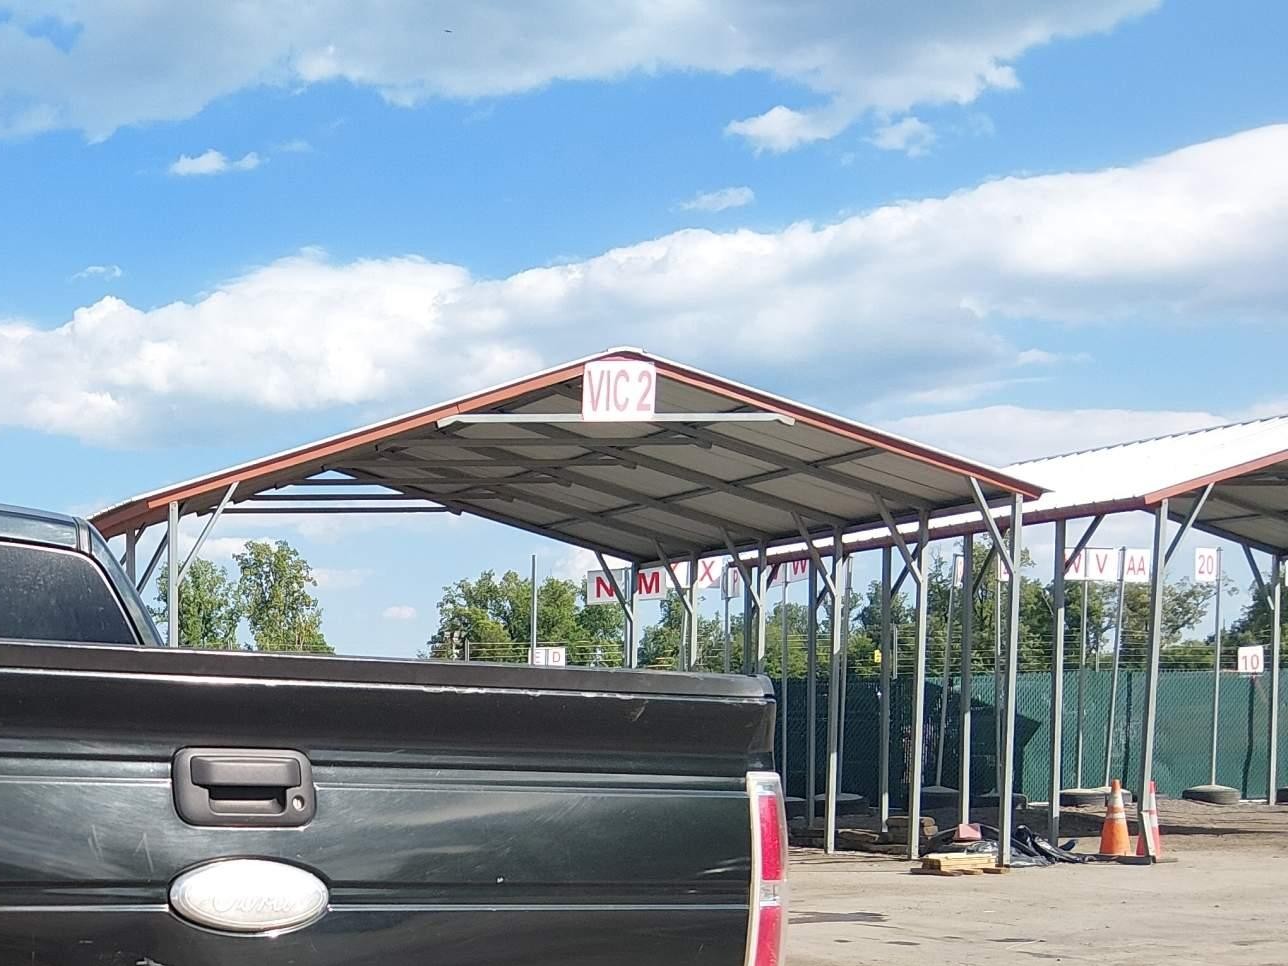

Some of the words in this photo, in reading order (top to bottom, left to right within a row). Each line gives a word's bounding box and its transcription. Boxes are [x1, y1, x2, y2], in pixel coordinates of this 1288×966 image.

[587, 369, 630, 412] VIC
[636, 370, 652, 411] 2
[699, 560, 715, 582] X
[1095, 554, 1108, 574] V
[1127, 555, 1145, 575] AA
[1198, 554, 1214, 575] 20
[596, 576, 616, 598] N
[638, 571, 660, 595] M
[552, 651, 561, 663] D
[1241, 654, 1259, 670] 10
